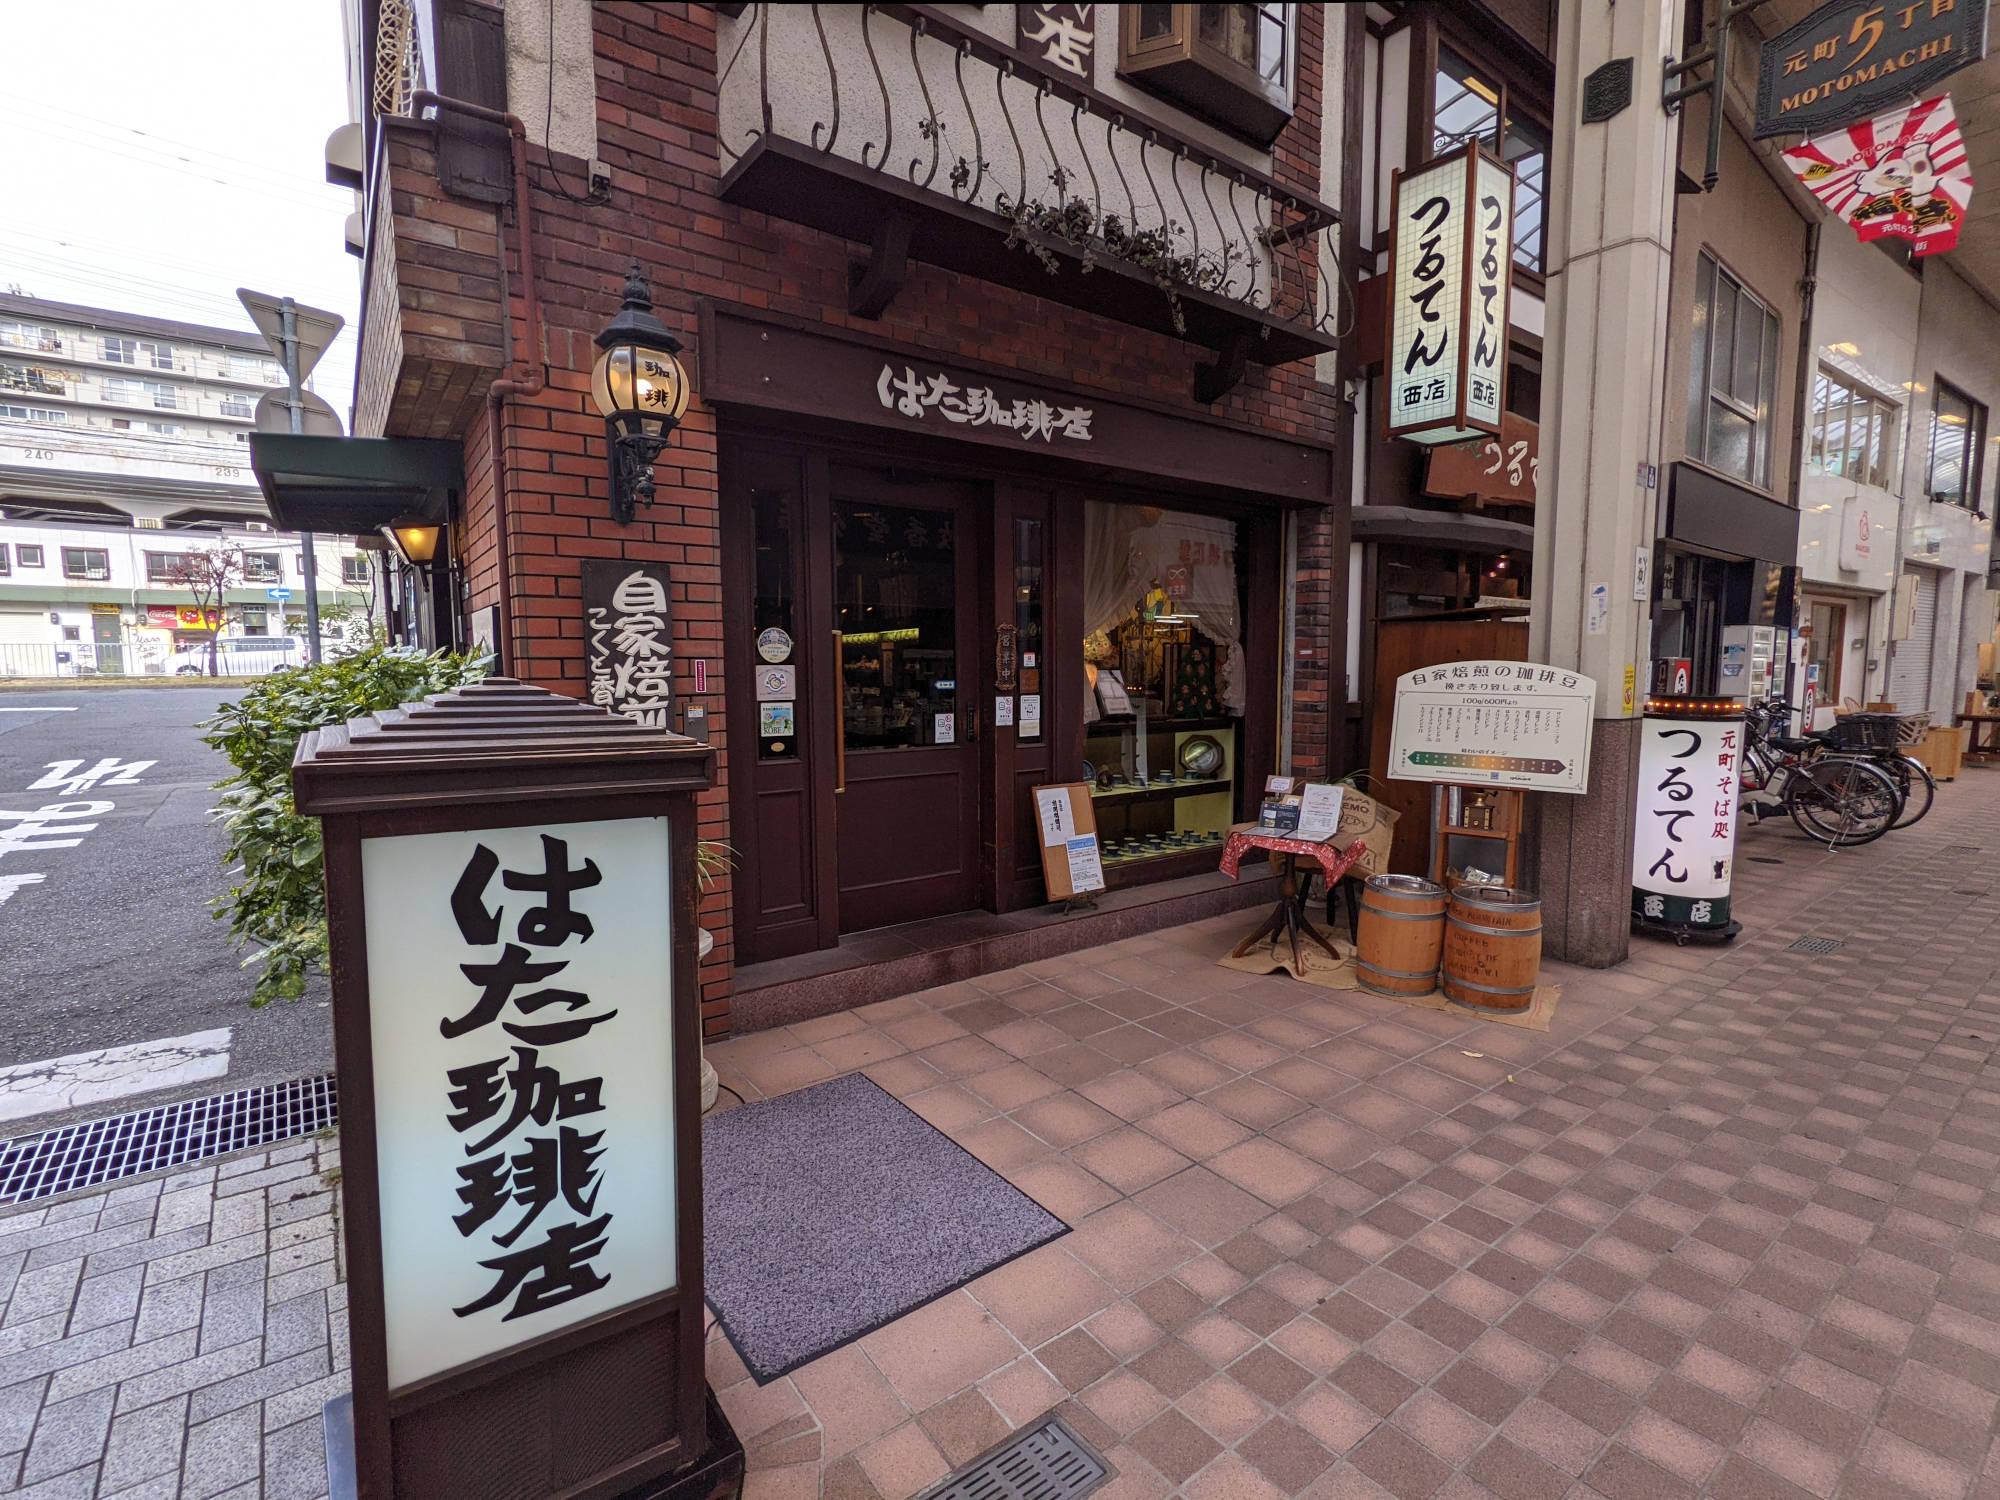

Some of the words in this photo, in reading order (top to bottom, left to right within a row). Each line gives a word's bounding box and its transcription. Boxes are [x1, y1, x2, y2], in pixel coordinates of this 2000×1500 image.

[1779, 34, 1953, 114] MOTOMACHI
[1838, 131, 1940, 169] MOTOMACHI
[1403, 196, 1451, 375] つるてん
[1474, 195, 1502, 369] つるてん
[644, 360, 671, 408] 珈琲
[877, 363, 1093, 443] はた珈琲店
[1403, 379, 1447, 407] 西店
[1473, 380, 1495, 406] 西店
[24, 449, 54, 461] 240
[215, 467, 240, 478] 239
[588, 608, 616, 714] こくと香
[1412, 665, 1580, 690] 自家焙煎の珈琲豆
[1649, 729, 1702, 883] つるてん
[1711, 730, 1736, 839] 元町そば処
[1643, 895, 1712, 923] 西店
[440, 834, 618, 1322] はた珈琲店
